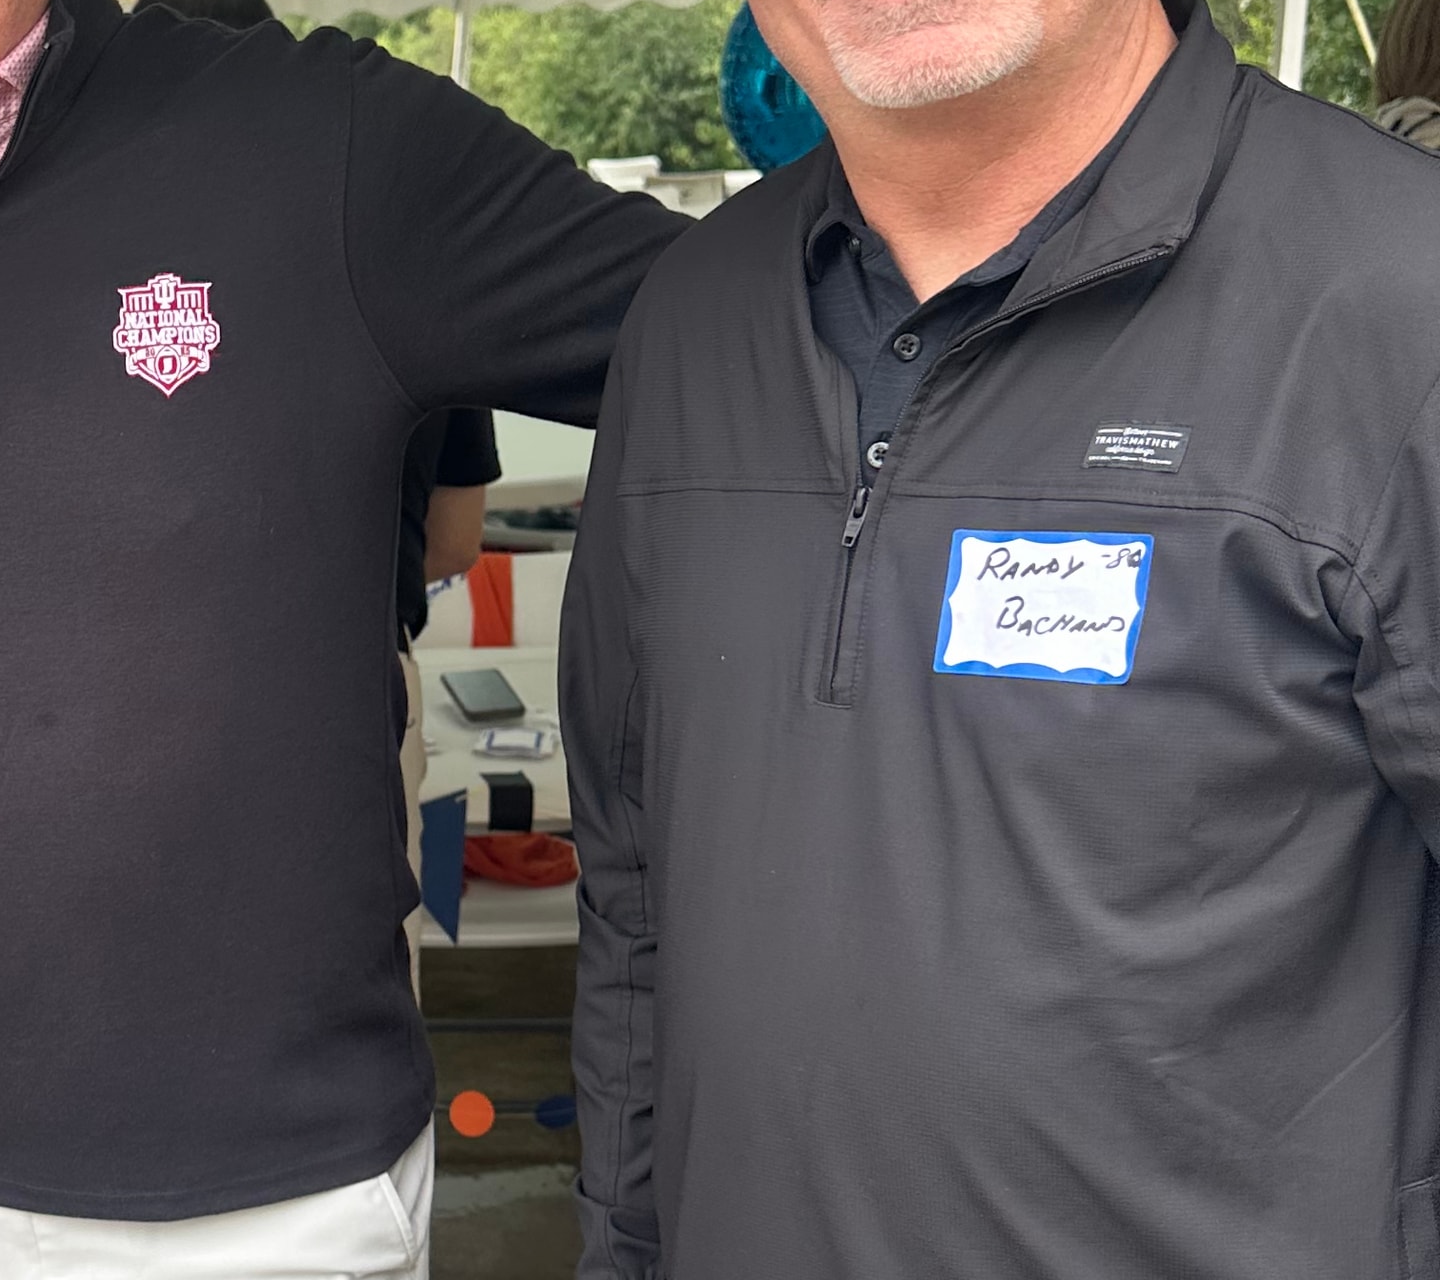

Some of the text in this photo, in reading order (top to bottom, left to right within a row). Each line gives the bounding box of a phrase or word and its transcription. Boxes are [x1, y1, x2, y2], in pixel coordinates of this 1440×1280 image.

[124, 308, 208, 330] NATIONAL
[117, 325, 217, 348] CHAMPIONS
[1094, 435, 1180, 449] TRAVISMATHEW
